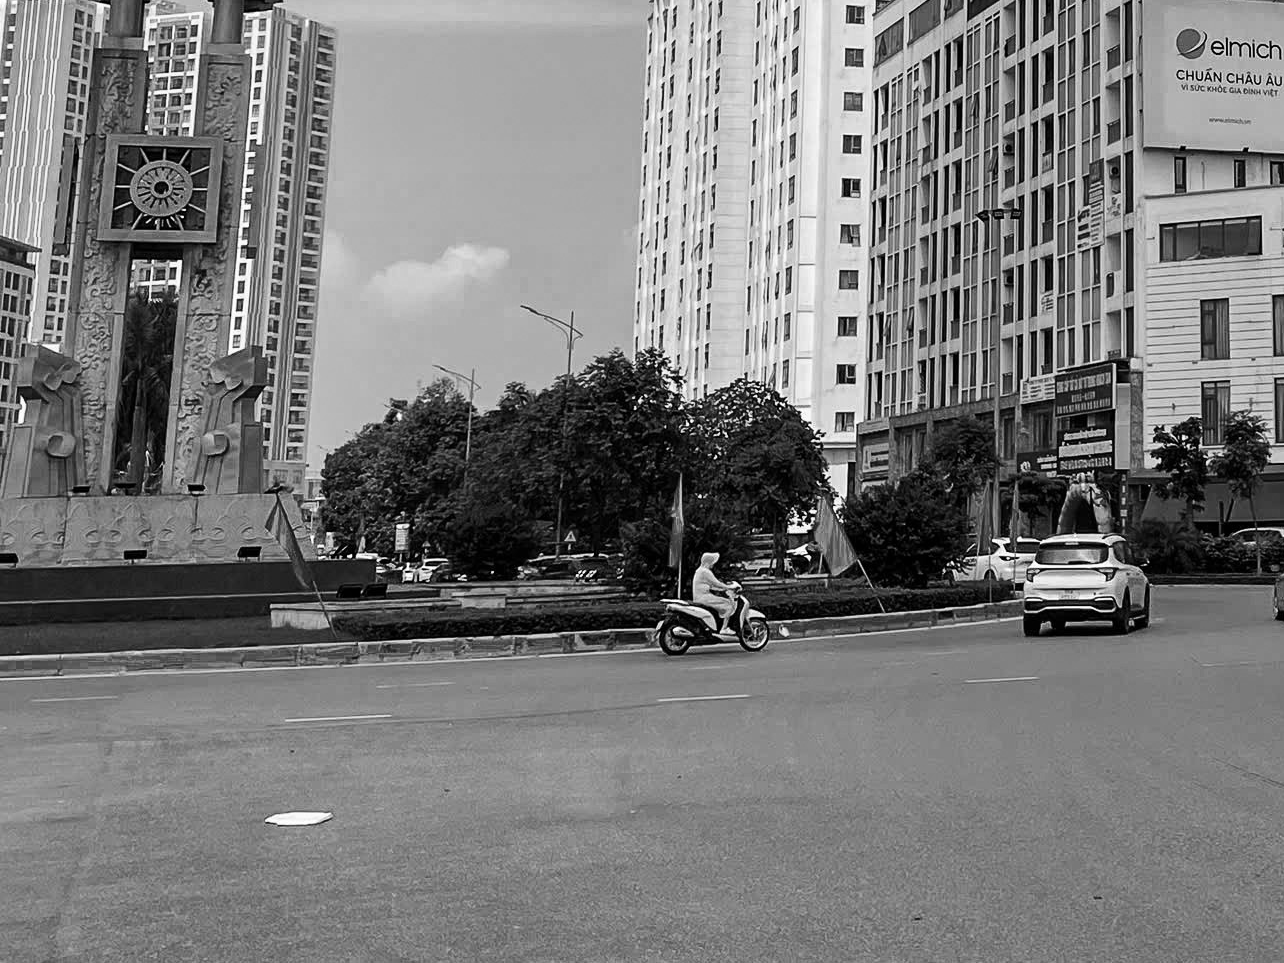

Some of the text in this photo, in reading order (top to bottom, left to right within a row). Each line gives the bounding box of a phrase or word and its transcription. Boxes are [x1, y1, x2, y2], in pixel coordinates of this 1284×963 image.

[1210, 36, 1283, 61] elmich
[1226, 71, 1262, 86] CHÂU
[1265, 72, 1283, 87] ÂU
[1229, 86, 1242, 94] GIA
